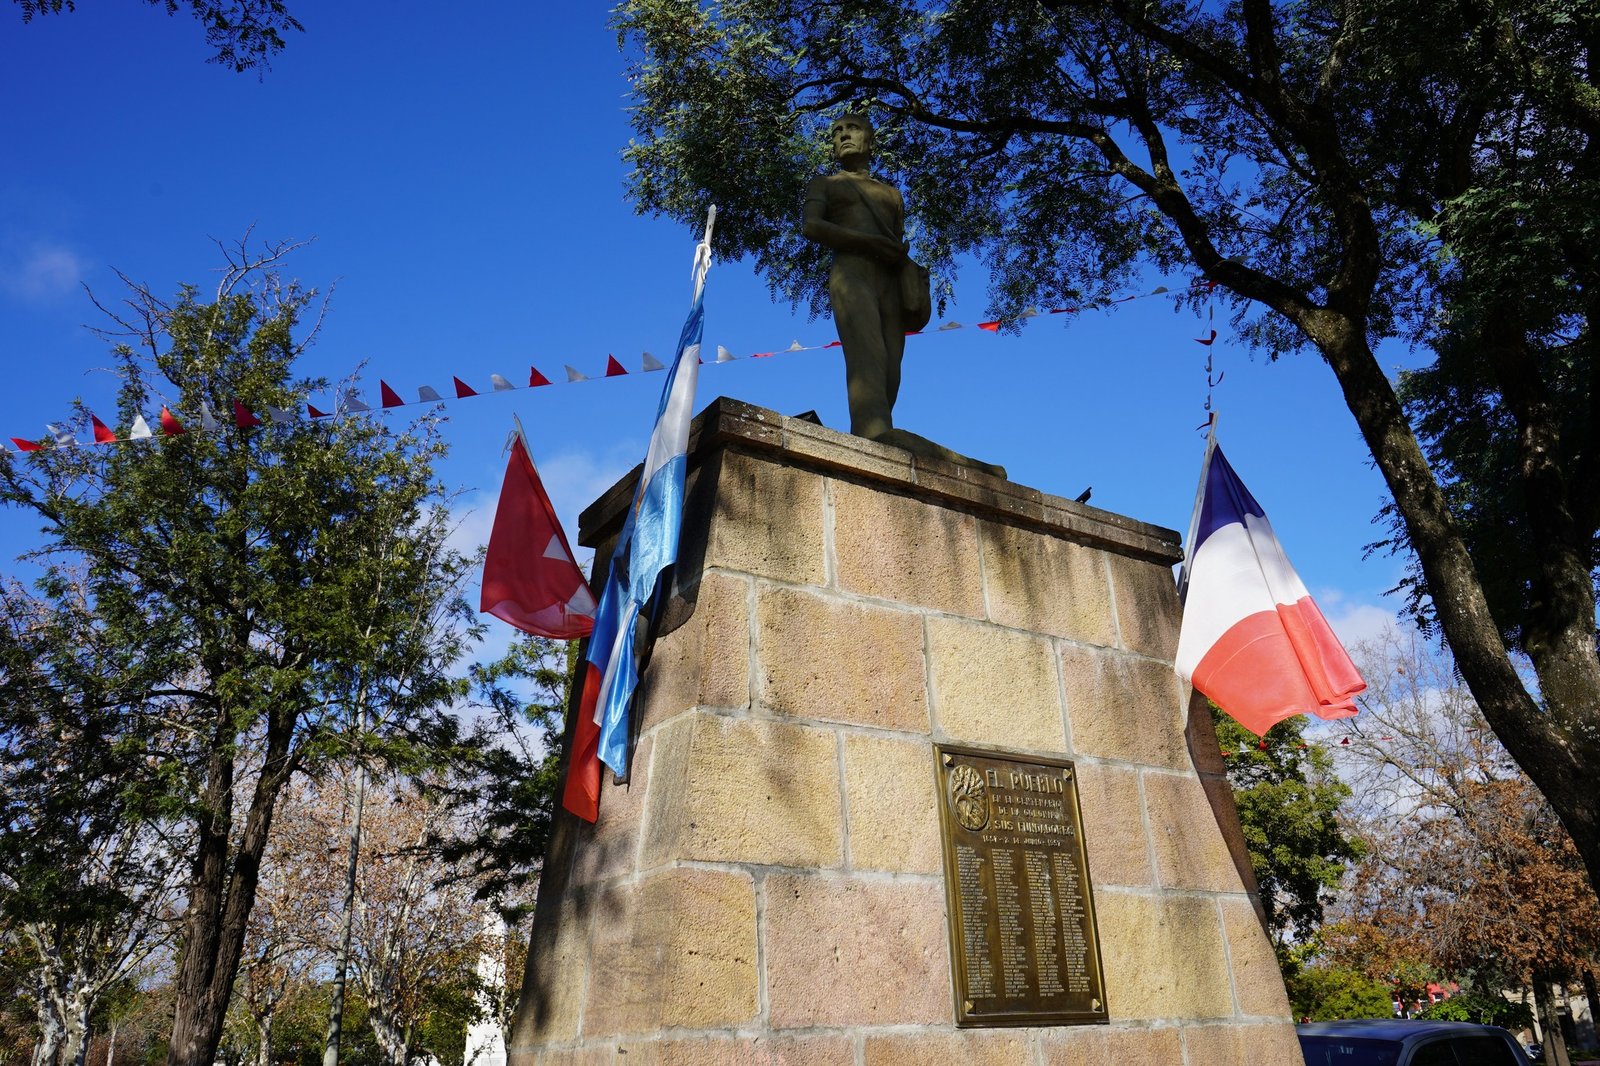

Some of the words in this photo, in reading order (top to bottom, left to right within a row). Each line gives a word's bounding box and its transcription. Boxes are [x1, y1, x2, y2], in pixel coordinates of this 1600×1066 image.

[985, 770, 1004, 789] EL
[1010, 772, 1063, 794] PUEBLO
[994, 819, 1014, 831] SUS
[1017, 821, 1074, 835] FUNDADORES
